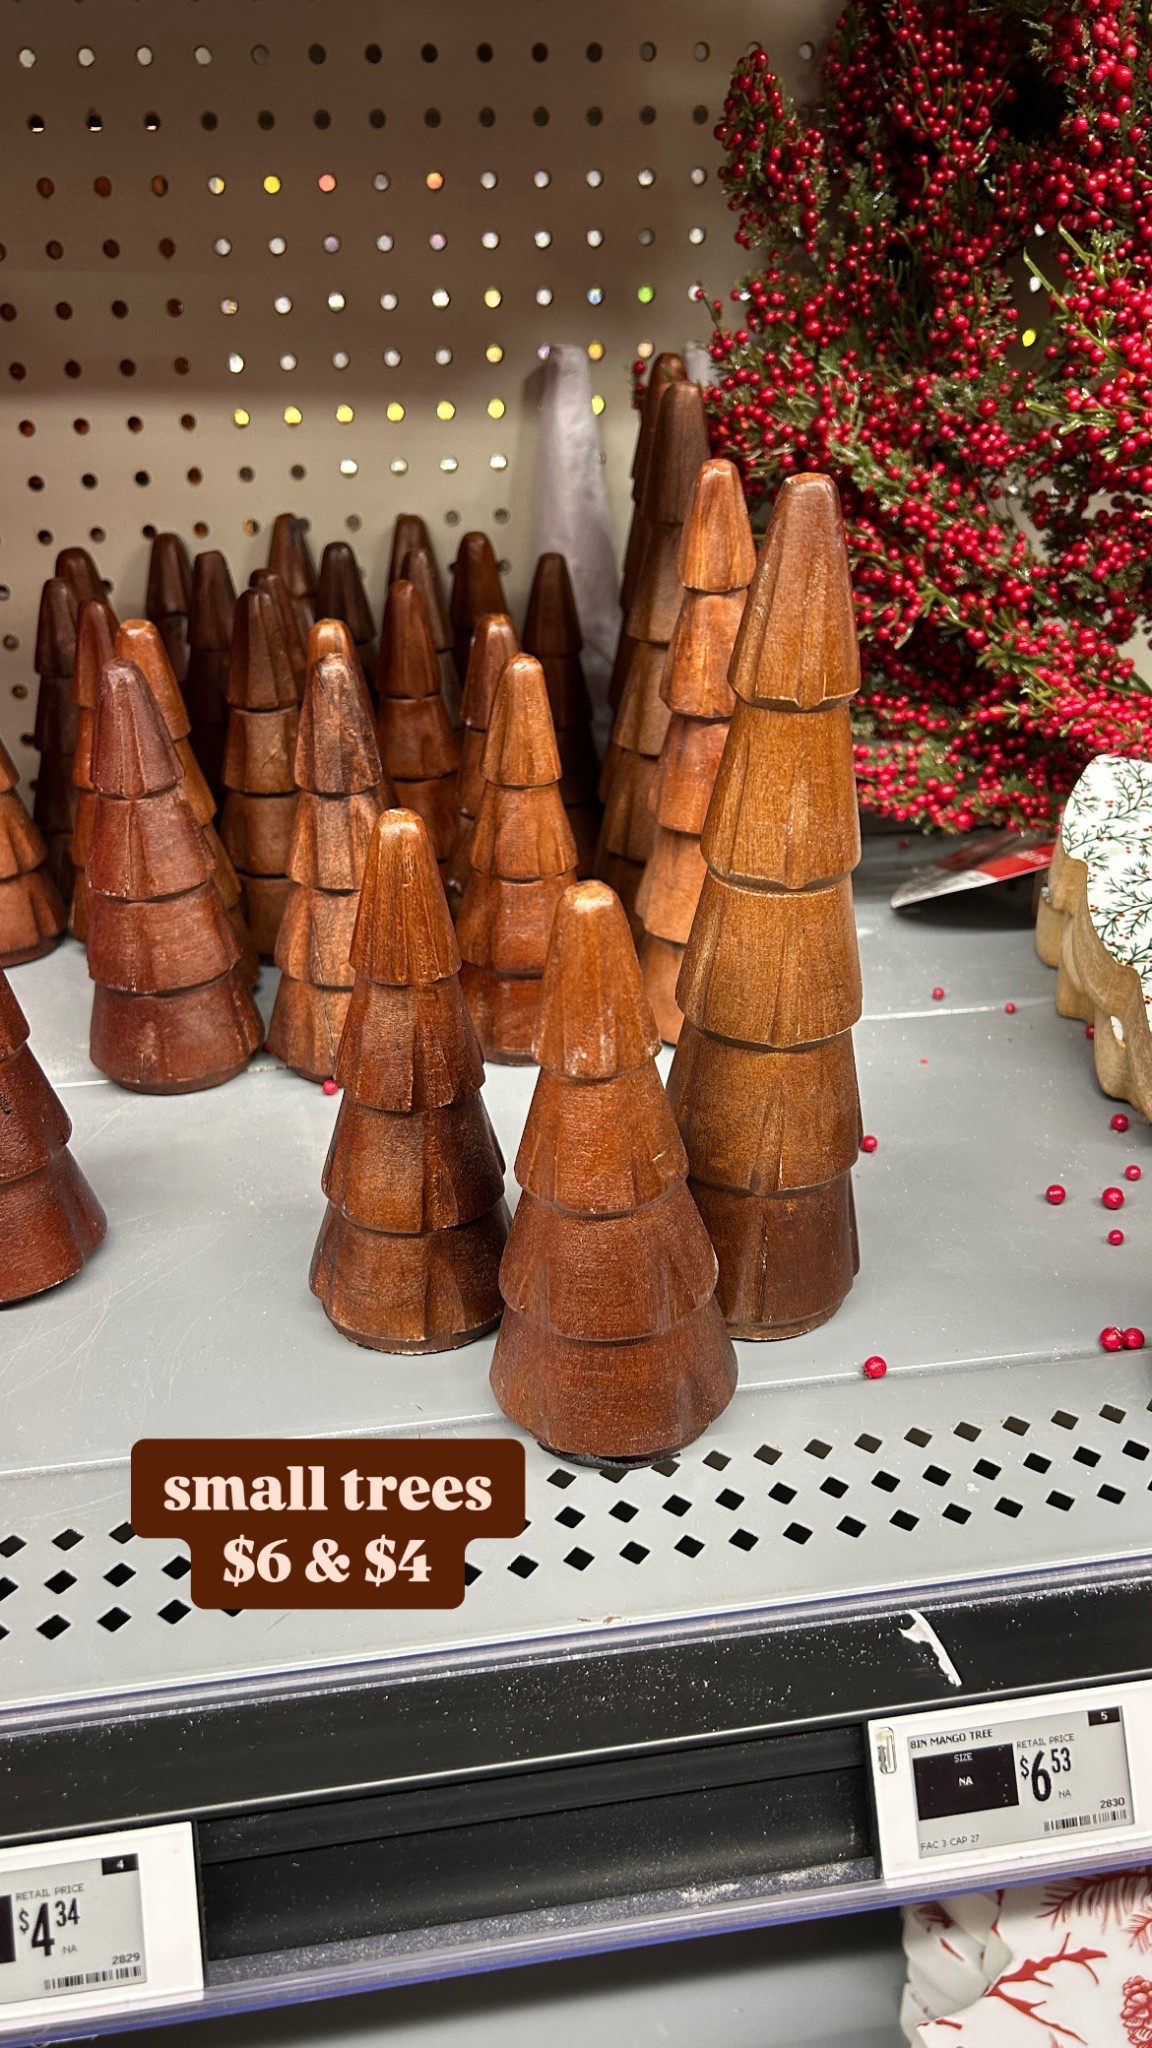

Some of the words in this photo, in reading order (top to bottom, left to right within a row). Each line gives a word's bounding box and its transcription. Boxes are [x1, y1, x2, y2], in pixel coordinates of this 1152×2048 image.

[1100, 1711, 1109, 1721] 5
[910, 1739, 928, 1750] 8IN
[929, 1732, 967, 1746] MANGO
[969, 1728, 994, 1741] TREE
[1016, 1737, 1046, 1749] RETAIL
[1049, 1733, 1076, 1744] PRICE
[953, 1752, 974, 1764] SIZE
[958, 1775, 974, 1787] NA
[1058, 1789, 1072, 1799] NA
[1100, 1797, 1126, 1809] 2830
[920, 1840, 939, 1851] FAC
[941, 1839, 947, 1848] 3
[949, 1836, 968, 1847] CAP
[970, 1834, 980, 1843] 27
[116, 1859, 125, 1870] 4
[16, 1888, 51, 1901] RETAIL
[54, 1883, 85, 1896] PRICE
[62, 1944, 78, 1955] NA
[111, 1952, 141, 1966] 2829
